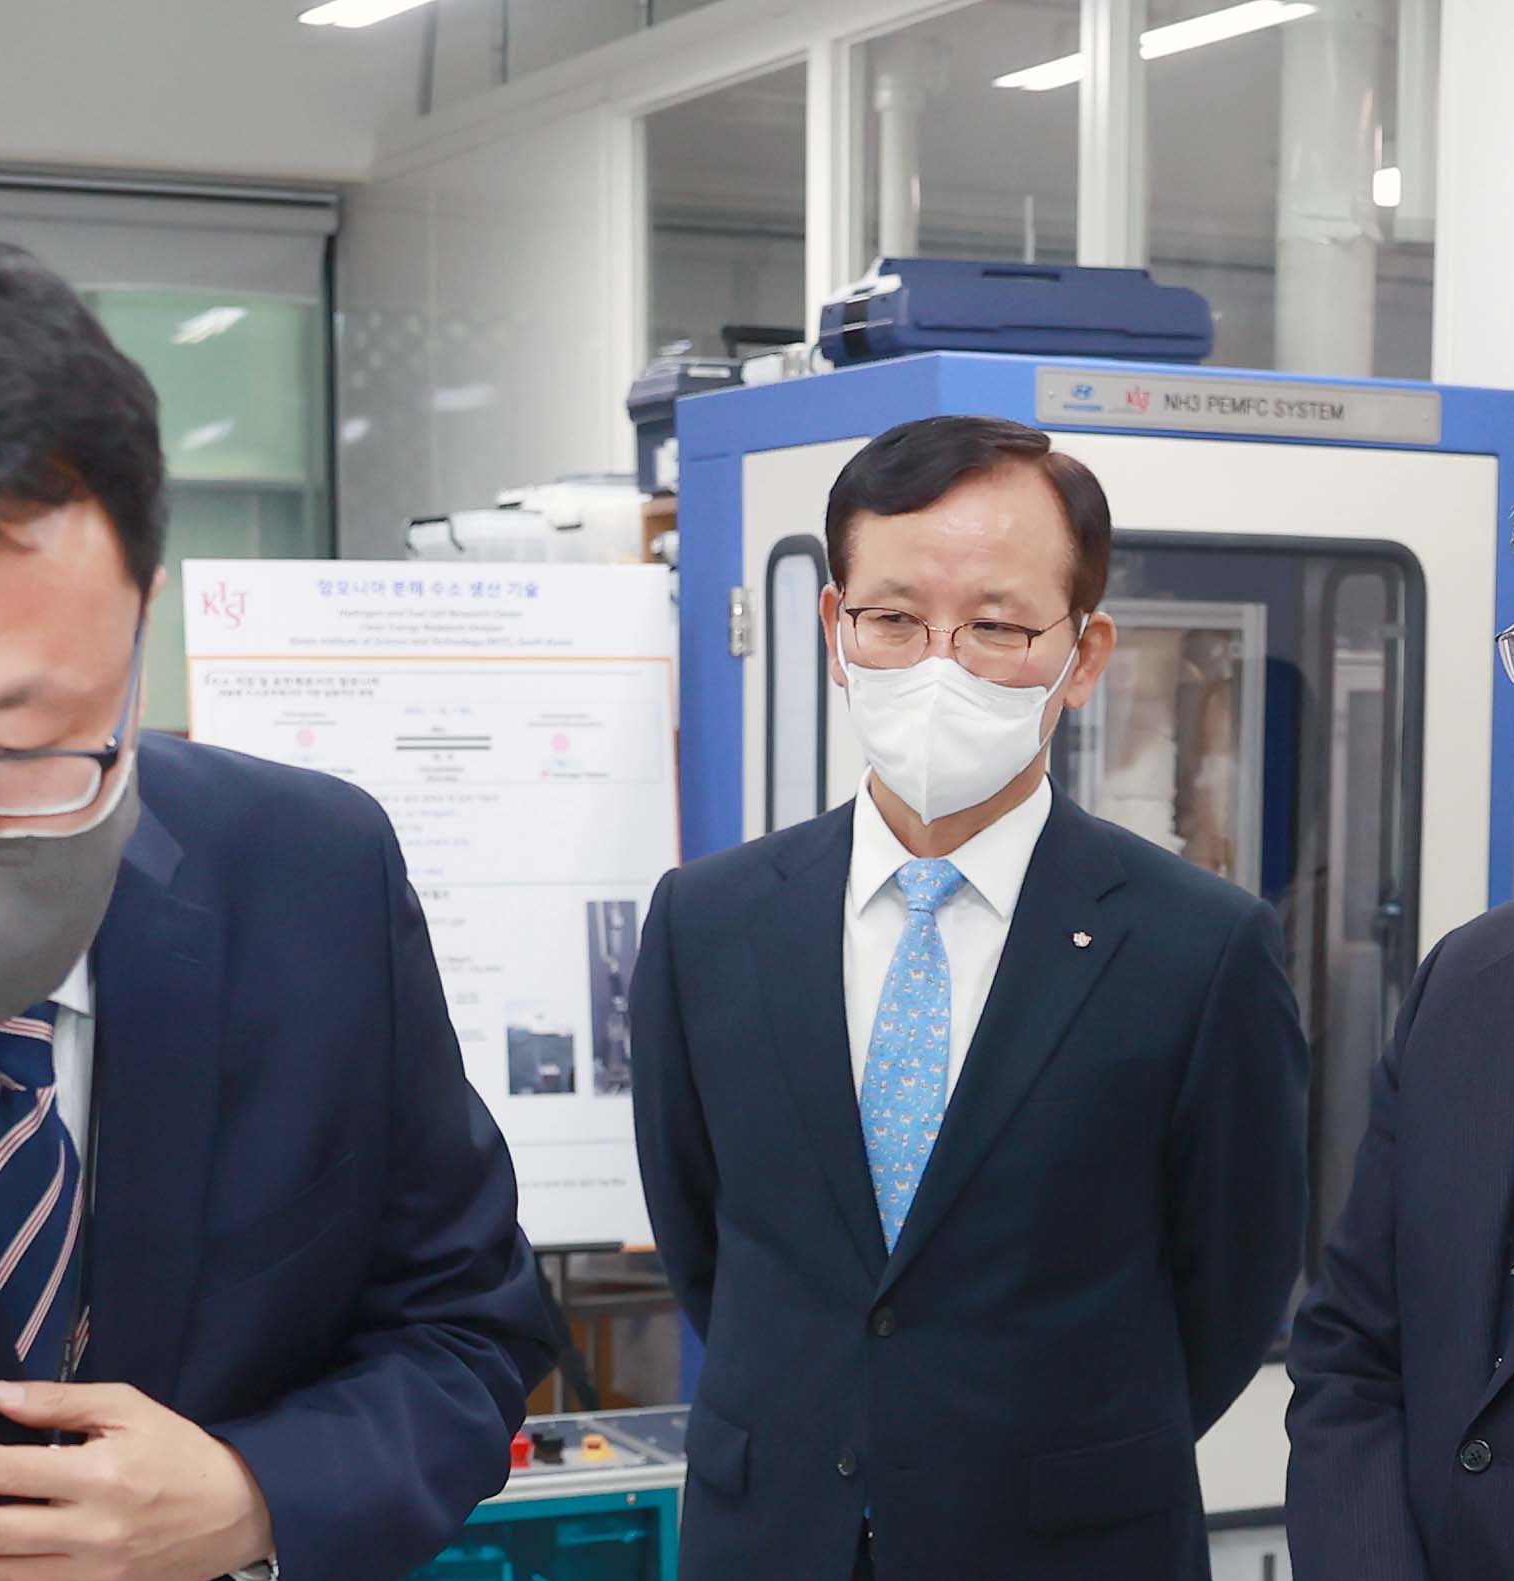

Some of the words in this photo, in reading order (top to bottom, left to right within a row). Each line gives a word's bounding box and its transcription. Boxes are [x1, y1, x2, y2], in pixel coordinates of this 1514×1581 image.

[1164, 394, 1201, 413] NH3
[1205, 396, 1269, 417] PEMFC
[1274, 400, 1345, 421] SYSTEM
